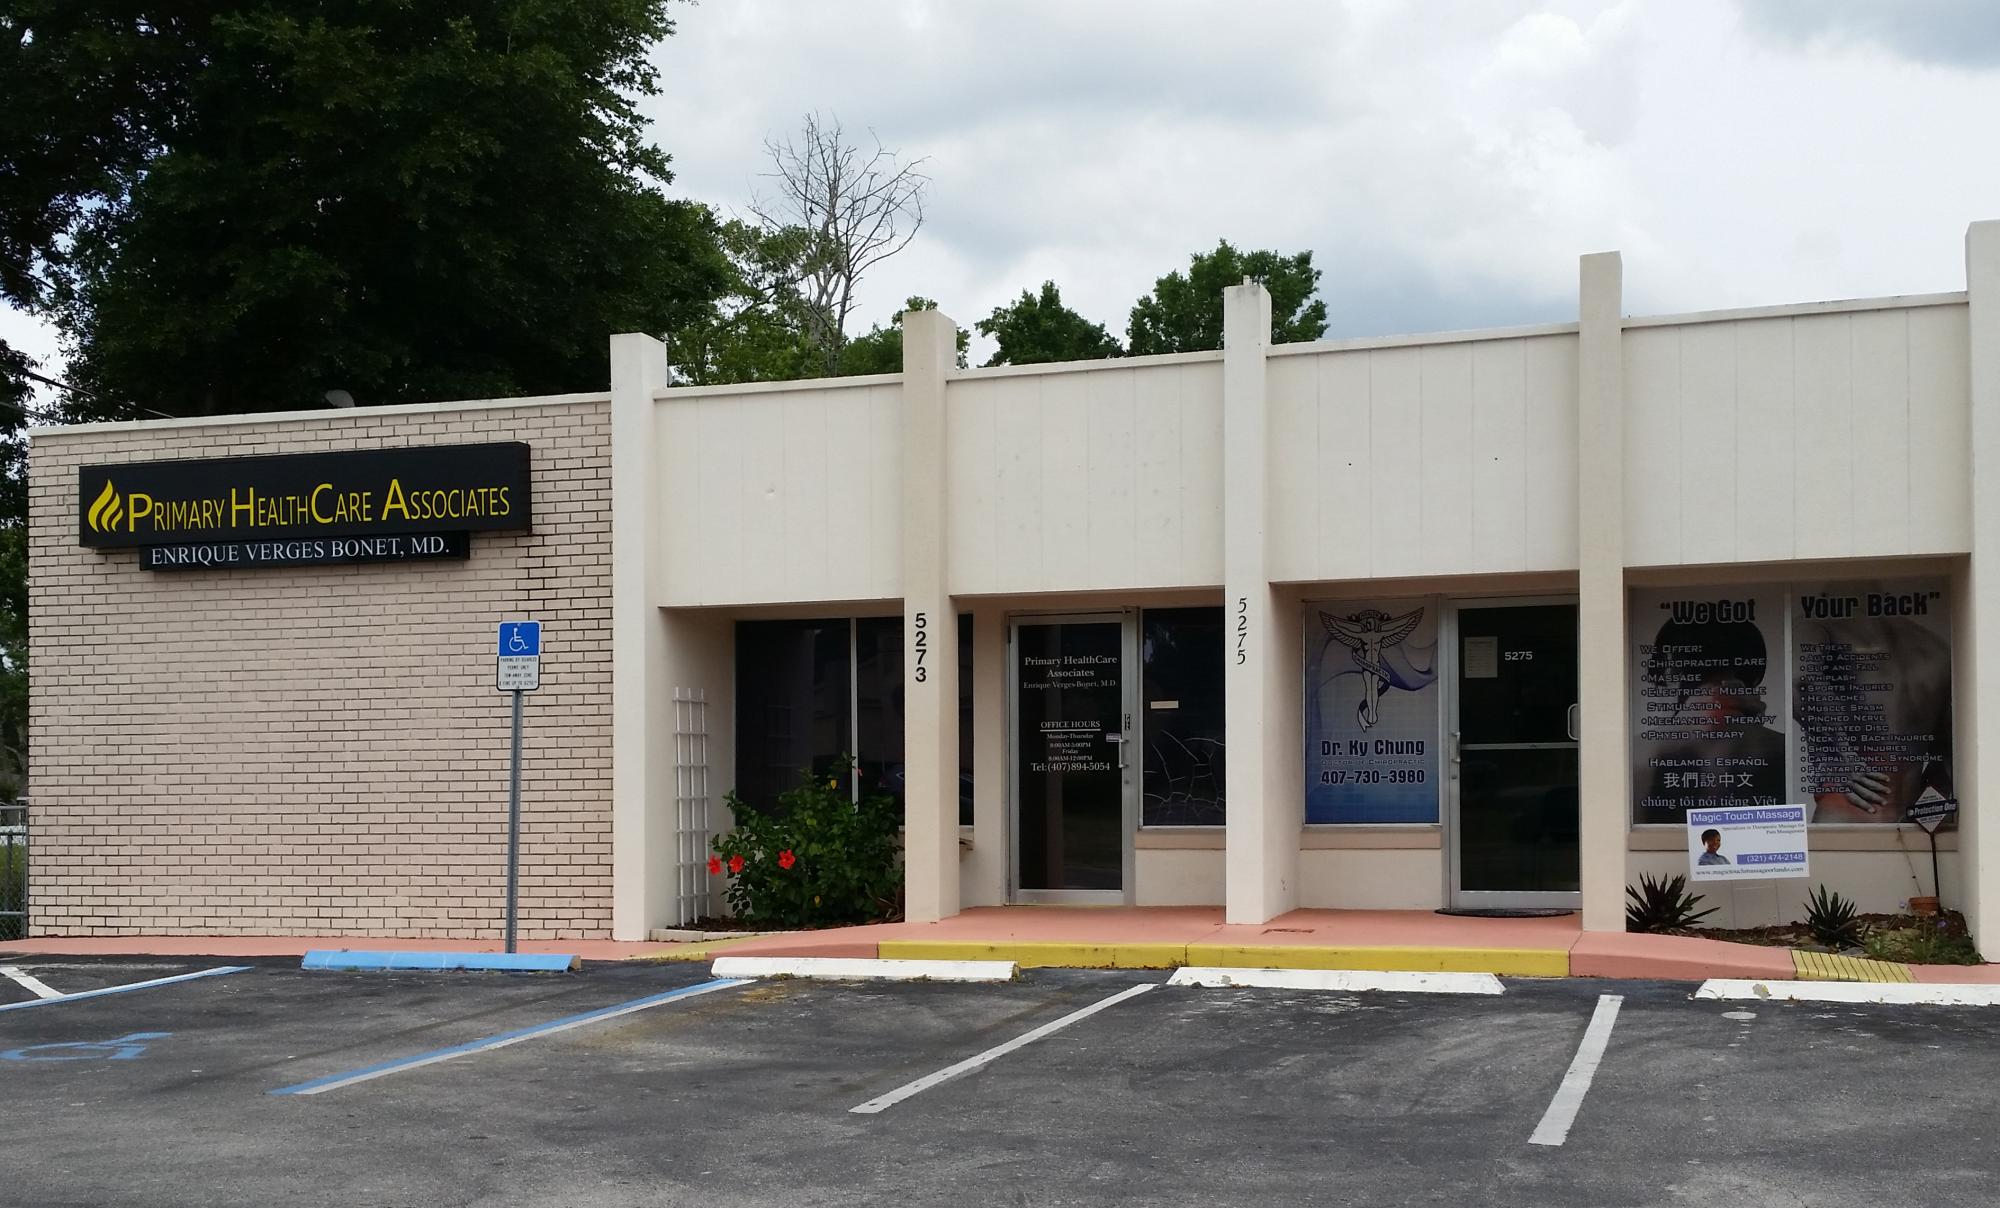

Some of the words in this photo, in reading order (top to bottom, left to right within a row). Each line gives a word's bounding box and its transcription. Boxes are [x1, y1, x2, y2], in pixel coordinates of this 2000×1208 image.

[128, 492, 225, 532] PRIMARY
[381, 478, 510, 521] ASSOCIATES
[151, 544, 239, 567] ENRIQUE
[245, 541, 325, 561] VERGES
[331, 538, 404, 559] BONET,
[410, 535, 450, 555] MD.
[1716, 599, 1756, 623] Got
[1801, 594, 1858, 618] Your
[1236, 597, 1247, 665] 5275
[915, 613, 927, 682] 5273
[1024, 656, 1062, 668] Primary
[1064, 655, 1118, 665] HealthCare
[1504, 651, 1533, 661] 5275
[1648, 658, 1730, 668] CHIROPRACTIC
[1734, 657, 1766, 667] CARE
[1047, 668, 1095, 678] Associates
[1648, 673, 1703, 683] MASSAGE
[1040, 721, 1069, 729] OFFICE
[1071, 720, 1101, 728] HOURS
[1321, 740, 1342, 756] Dr.
[1349, 740, 1368, 757] Ky
[1375, 739, 1425, 756] Chung
[1649, 758, 1711, 767] HABLAMOS
[1663, 771, 1754, 788] 我們說中文
[1692, 812, 1721, 823] Magic
[1724, 811, 1754, 821] Touch
[1756, 809, 1801, 820] Massage
[1746, 854, 1767, 863] (321)
